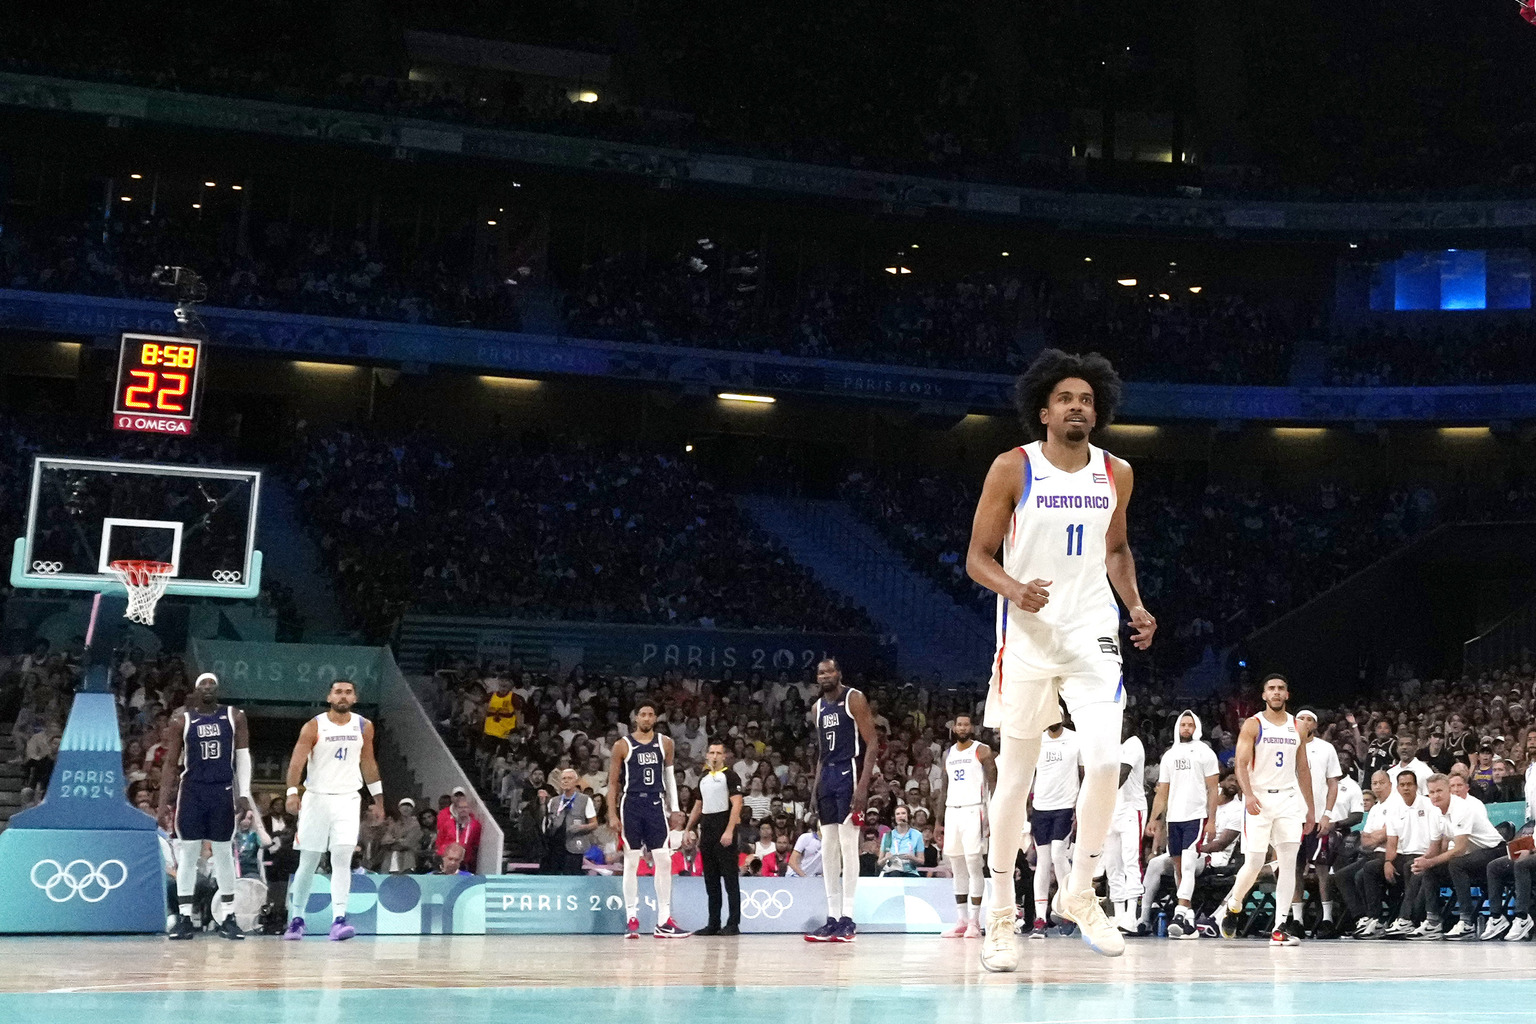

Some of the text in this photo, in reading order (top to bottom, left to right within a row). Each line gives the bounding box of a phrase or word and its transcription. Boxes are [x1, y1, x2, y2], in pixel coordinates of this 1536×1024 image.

[141, 343, 195, 368] 8:58
[125, 370, 188, 411] 22
[134, 418, 187, 433] OMEGA
[1036, 495, 1109, 510] PUERTO RICO
[1066, 523, 1084, 556] 11
[643, 643, 737, 668] PARIS
[823, 712, 840, 729] USA
[197, 723, 221, 738] USA
[825, 730, 836, 752] 7
[1262, 737, 1297, 746] PUERTO RICO
[200, 740, 221, 760] 13
[334, 747, 348, 760] 41
[1045, 751, 1062, 762] USA
[637, 752, 658, 766] USA
[1174, 759, 1191, 770] USA
[1275, 751, 1284, 767] 3
[62, 770, 114, 783] PARIS
[643, 767, 655, 785] 9
[953, 769, 965, 781] 32
[60, 785, 114, 798] 2024
[502, 895, 578, 911] PARIS
